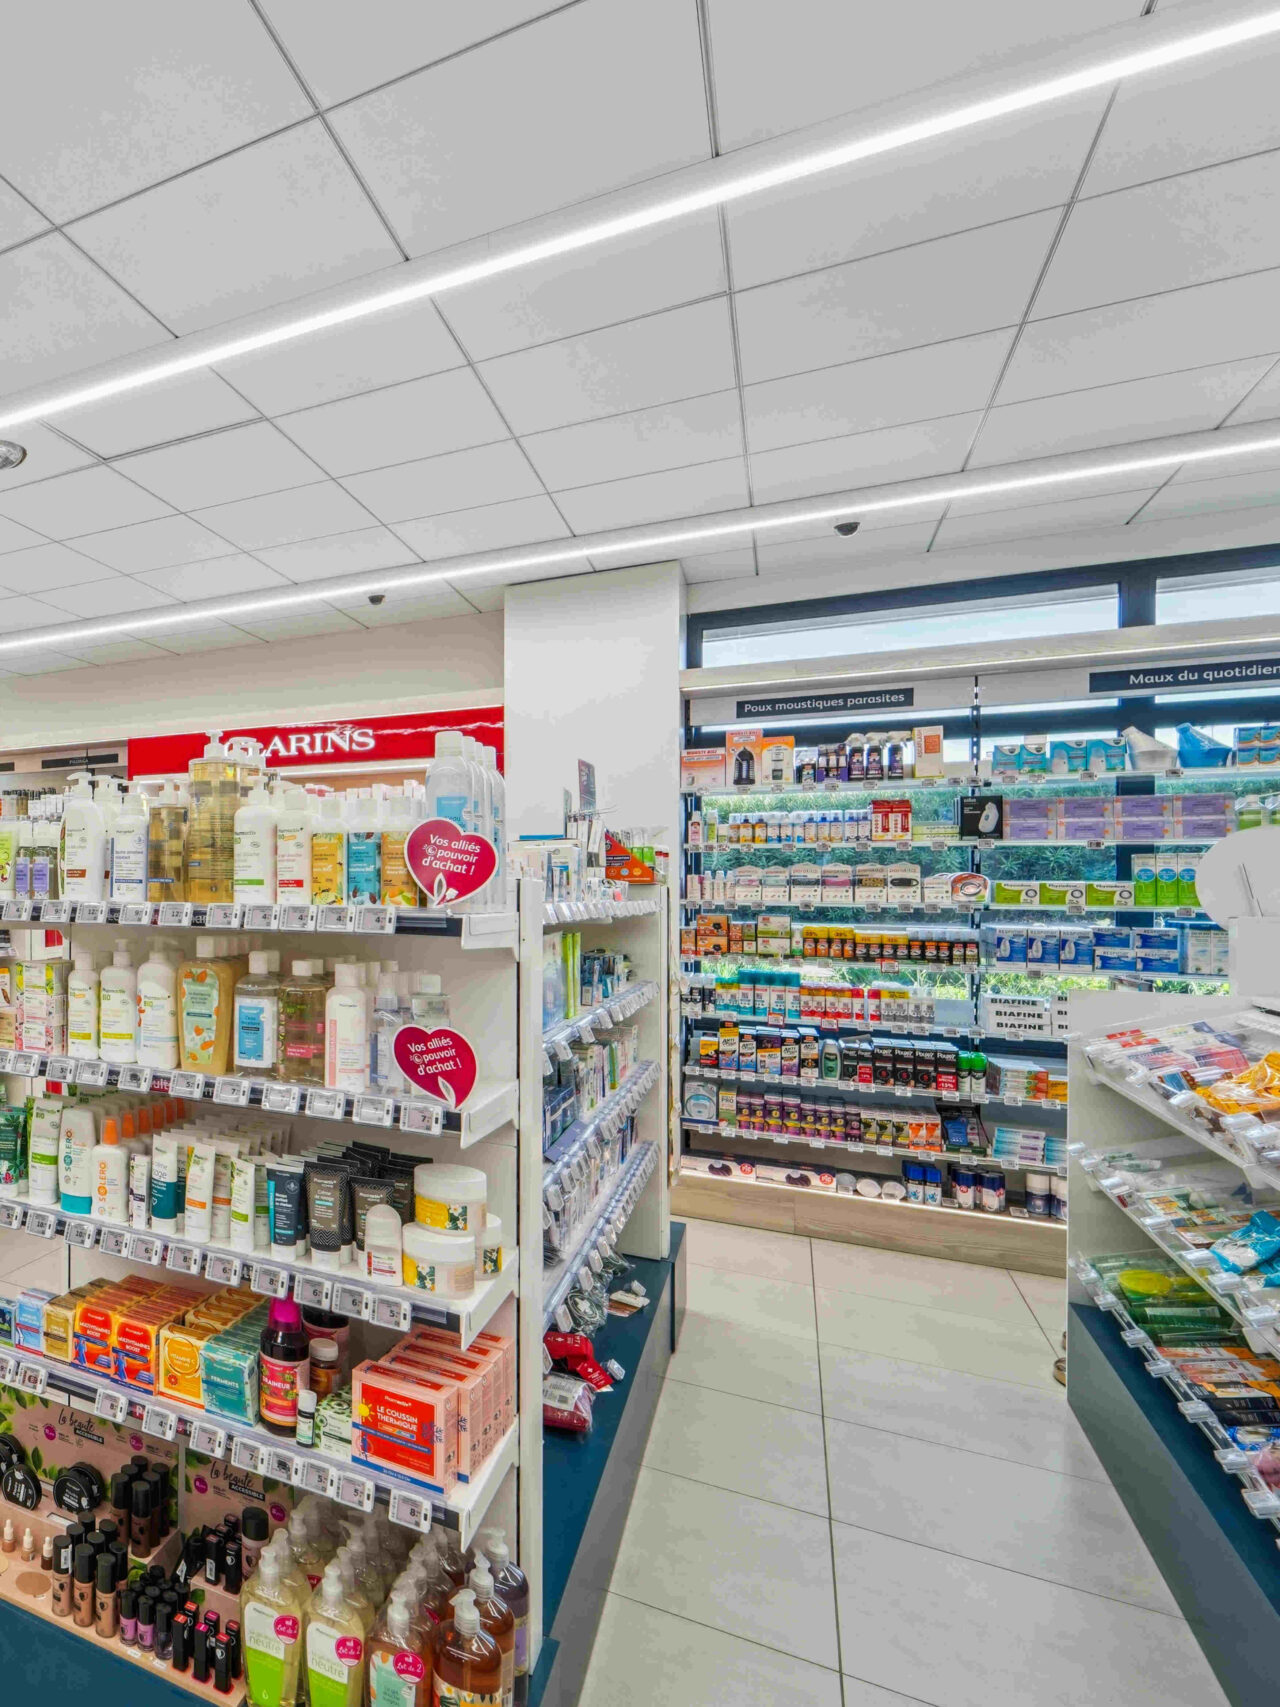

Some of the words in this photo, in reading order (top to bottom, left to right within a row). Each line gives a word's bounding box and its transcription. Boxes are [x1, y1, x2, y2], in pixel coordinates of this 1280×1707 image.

[1129, 673, 1174, 685] Maux
[1178, 669, 1198, 682] du
[744, 702, 773, 713] Poux
[775, 697, 845, 712] moustiques
[847, 692, 905, 707] parasites
[430, 833, 450, 846] Vos
[451, 838, 481, 853] alliés
[437, 849, 479, 863] pouvoir
[422, 855, 467, 875] d'achat
[990, 998, 1038, 1007] BIAFINE
[995, 1010, 1044, 1019] BIAFINE
[996, 1022, 1045, 1031] BIAFINE
[408, 1042, 427, 1054] Vos
[427, 1036, 453, 1050] alliés
[423, 1047, 456, 1063] pouvoir
[417, 1060, 456, 1076] d'achat
[376, 1404, 385, 1413] LE
[386, 1407, 418, 1424] COUSSIN
[376, 1412, 418, 1432] THERMIQUE
